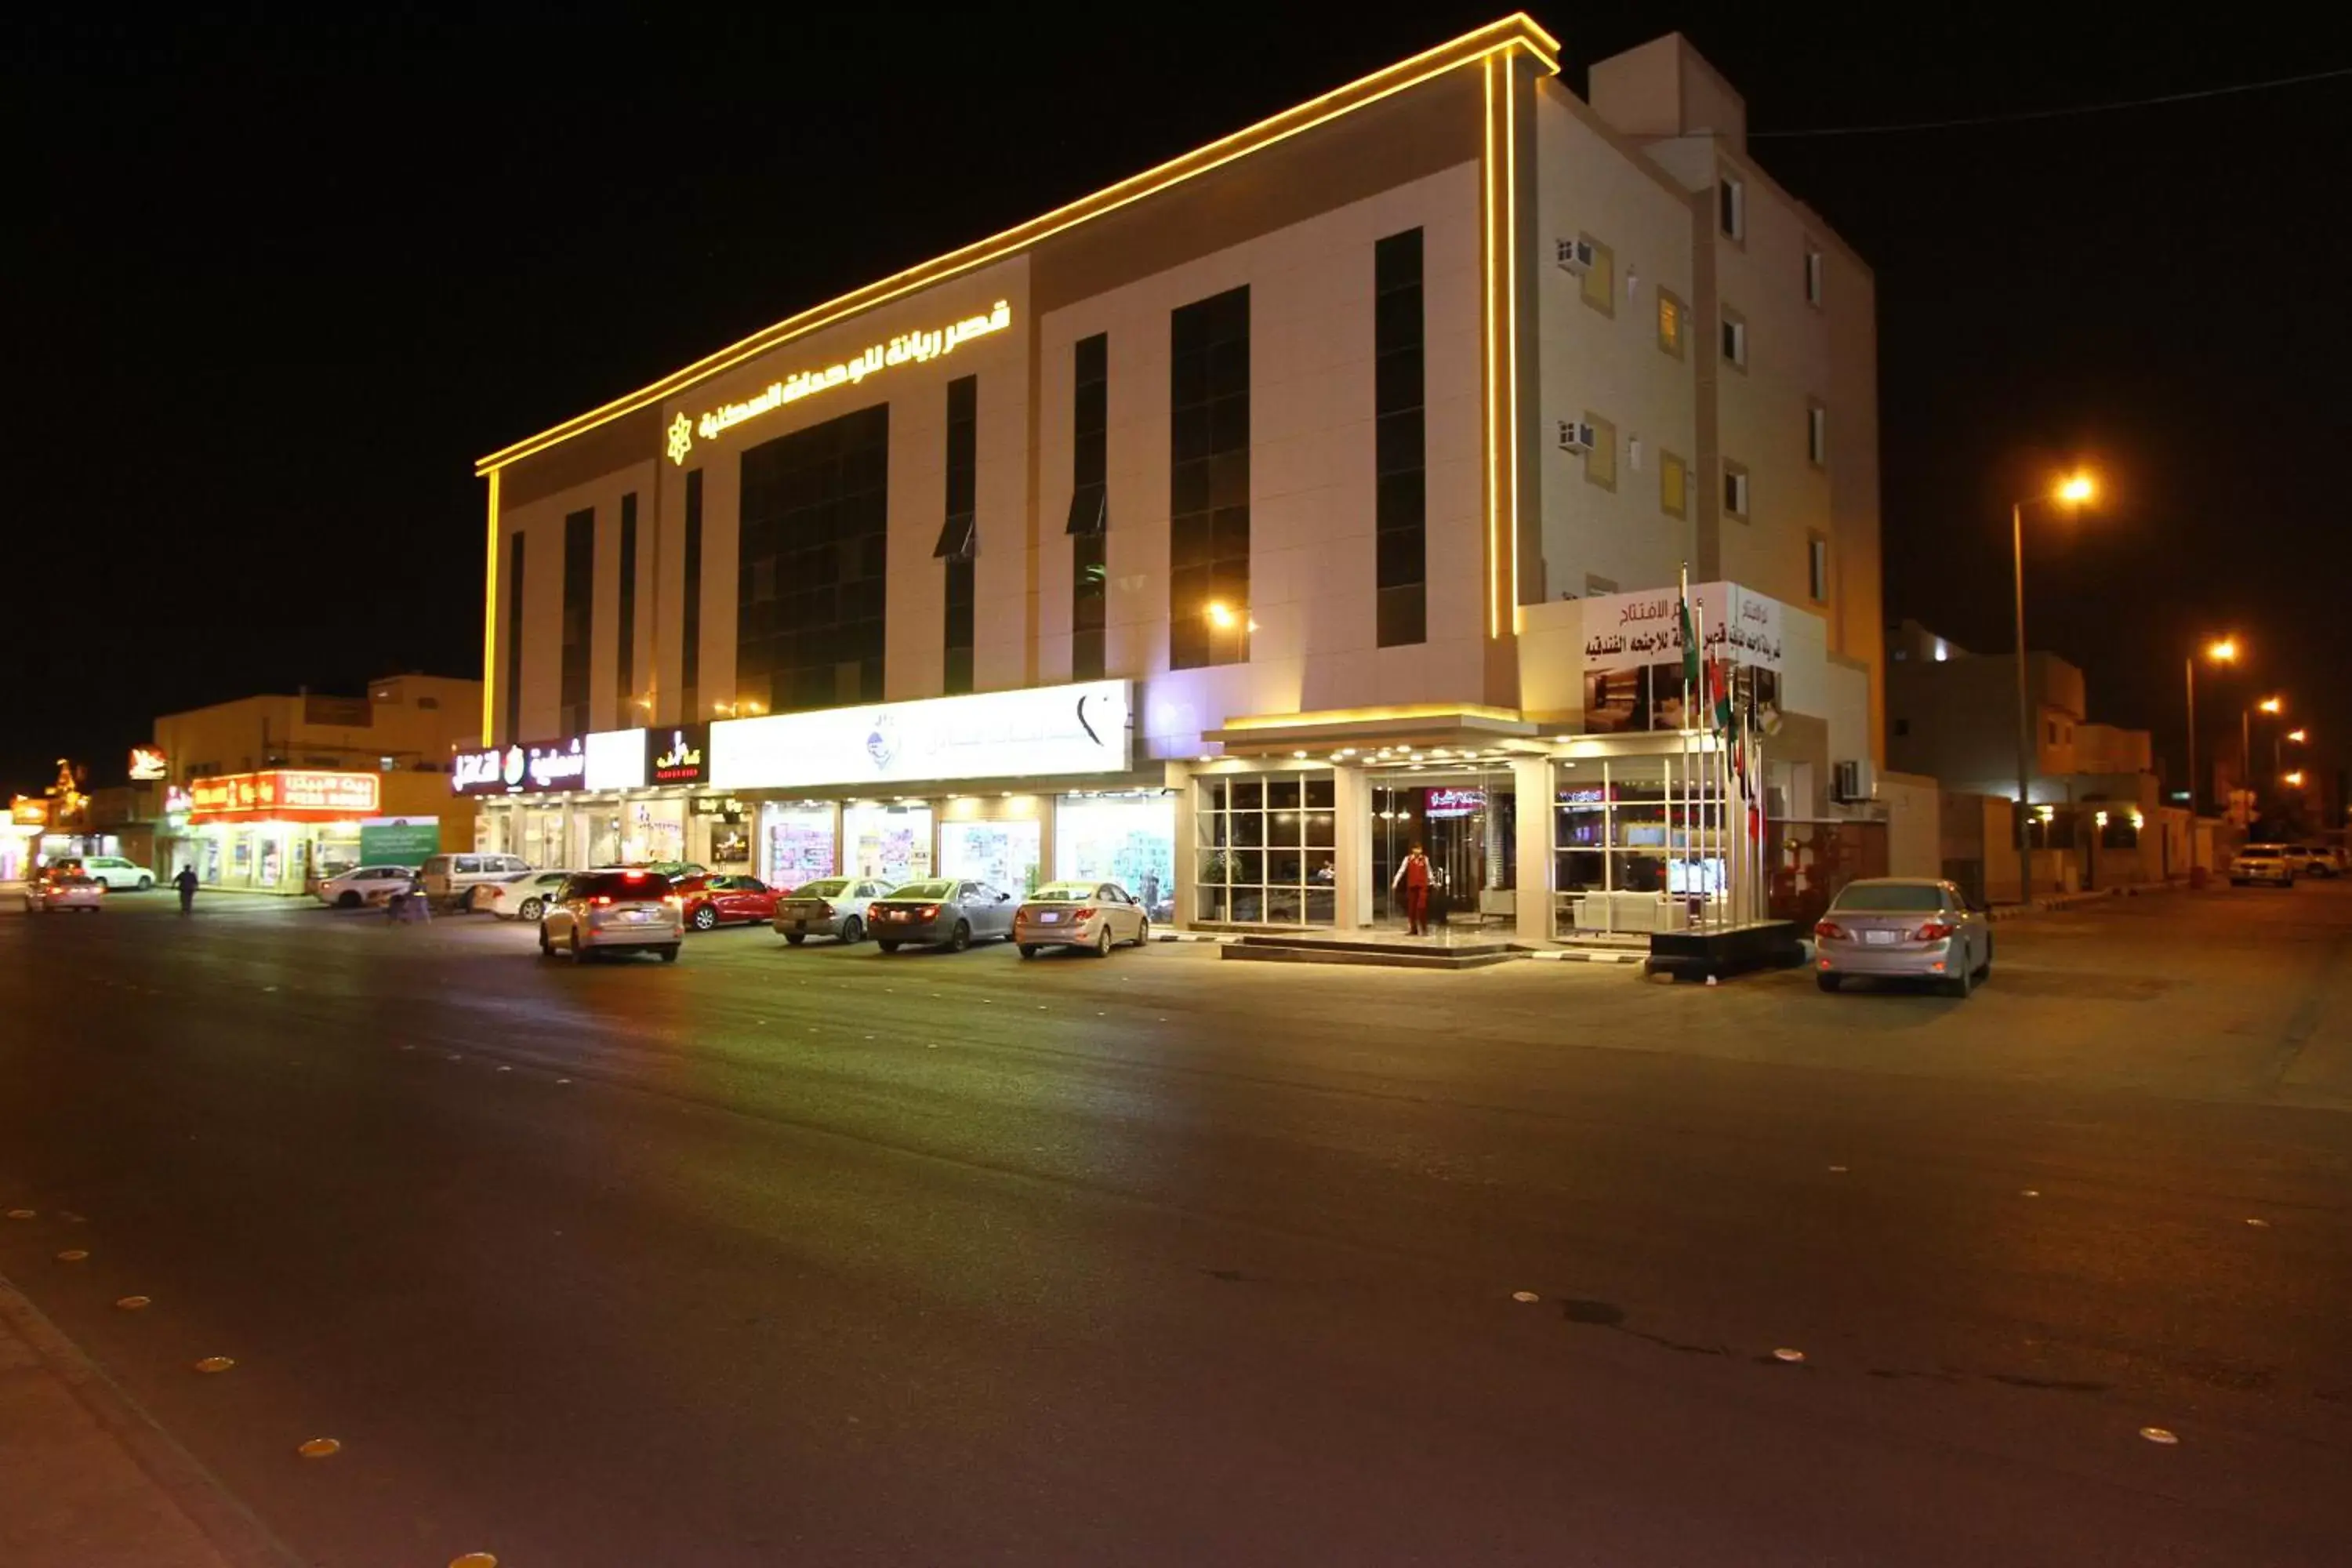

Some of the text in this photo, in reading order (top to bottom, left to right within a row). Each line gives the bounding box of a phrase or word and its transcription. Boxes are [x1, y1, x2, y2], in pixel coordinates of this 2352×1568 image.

[886, 329, 942, 363] ريانة
[943, 299, 1011, 354] قصر
[699, 381, 782, 440] السكنية
[1619, 599, 1668, 627] الافتتاح
